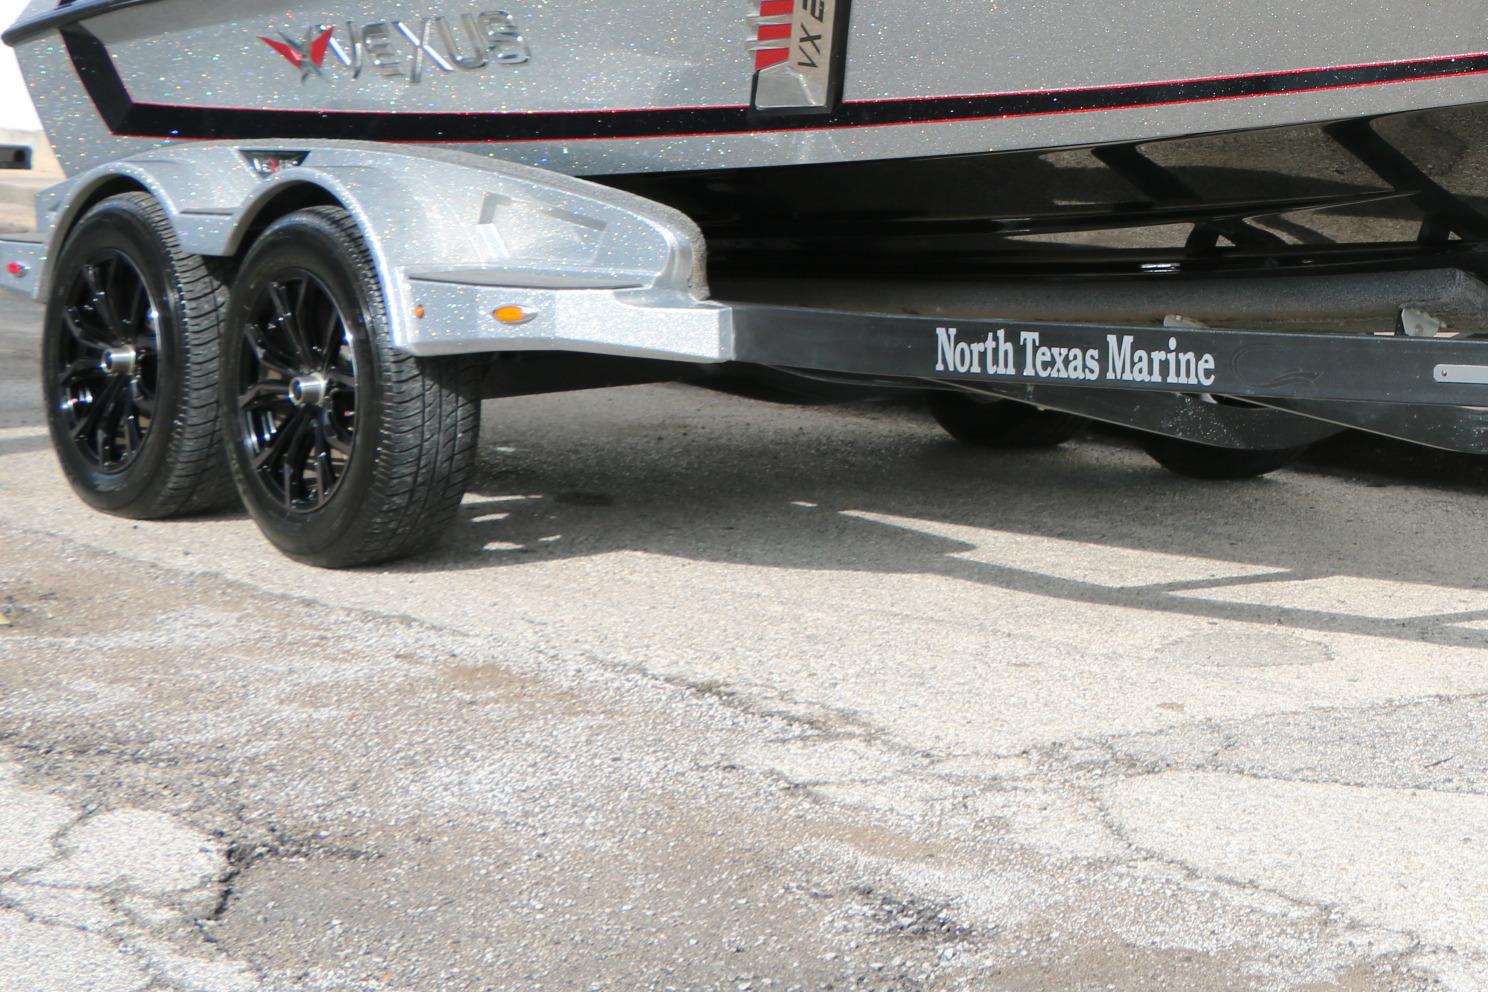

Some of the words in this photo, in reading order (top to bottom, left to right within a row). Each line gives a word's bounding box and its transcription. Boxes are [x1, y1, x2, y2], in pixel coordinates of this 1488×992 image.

[315, 9, 532, 85] VEXUS
[797, 22, 822, 68] VX
[935, 326, 1016, 376] North
[1020, 330, 1100, 381] Texas
[1105, 333, 1216, 387] Marine
